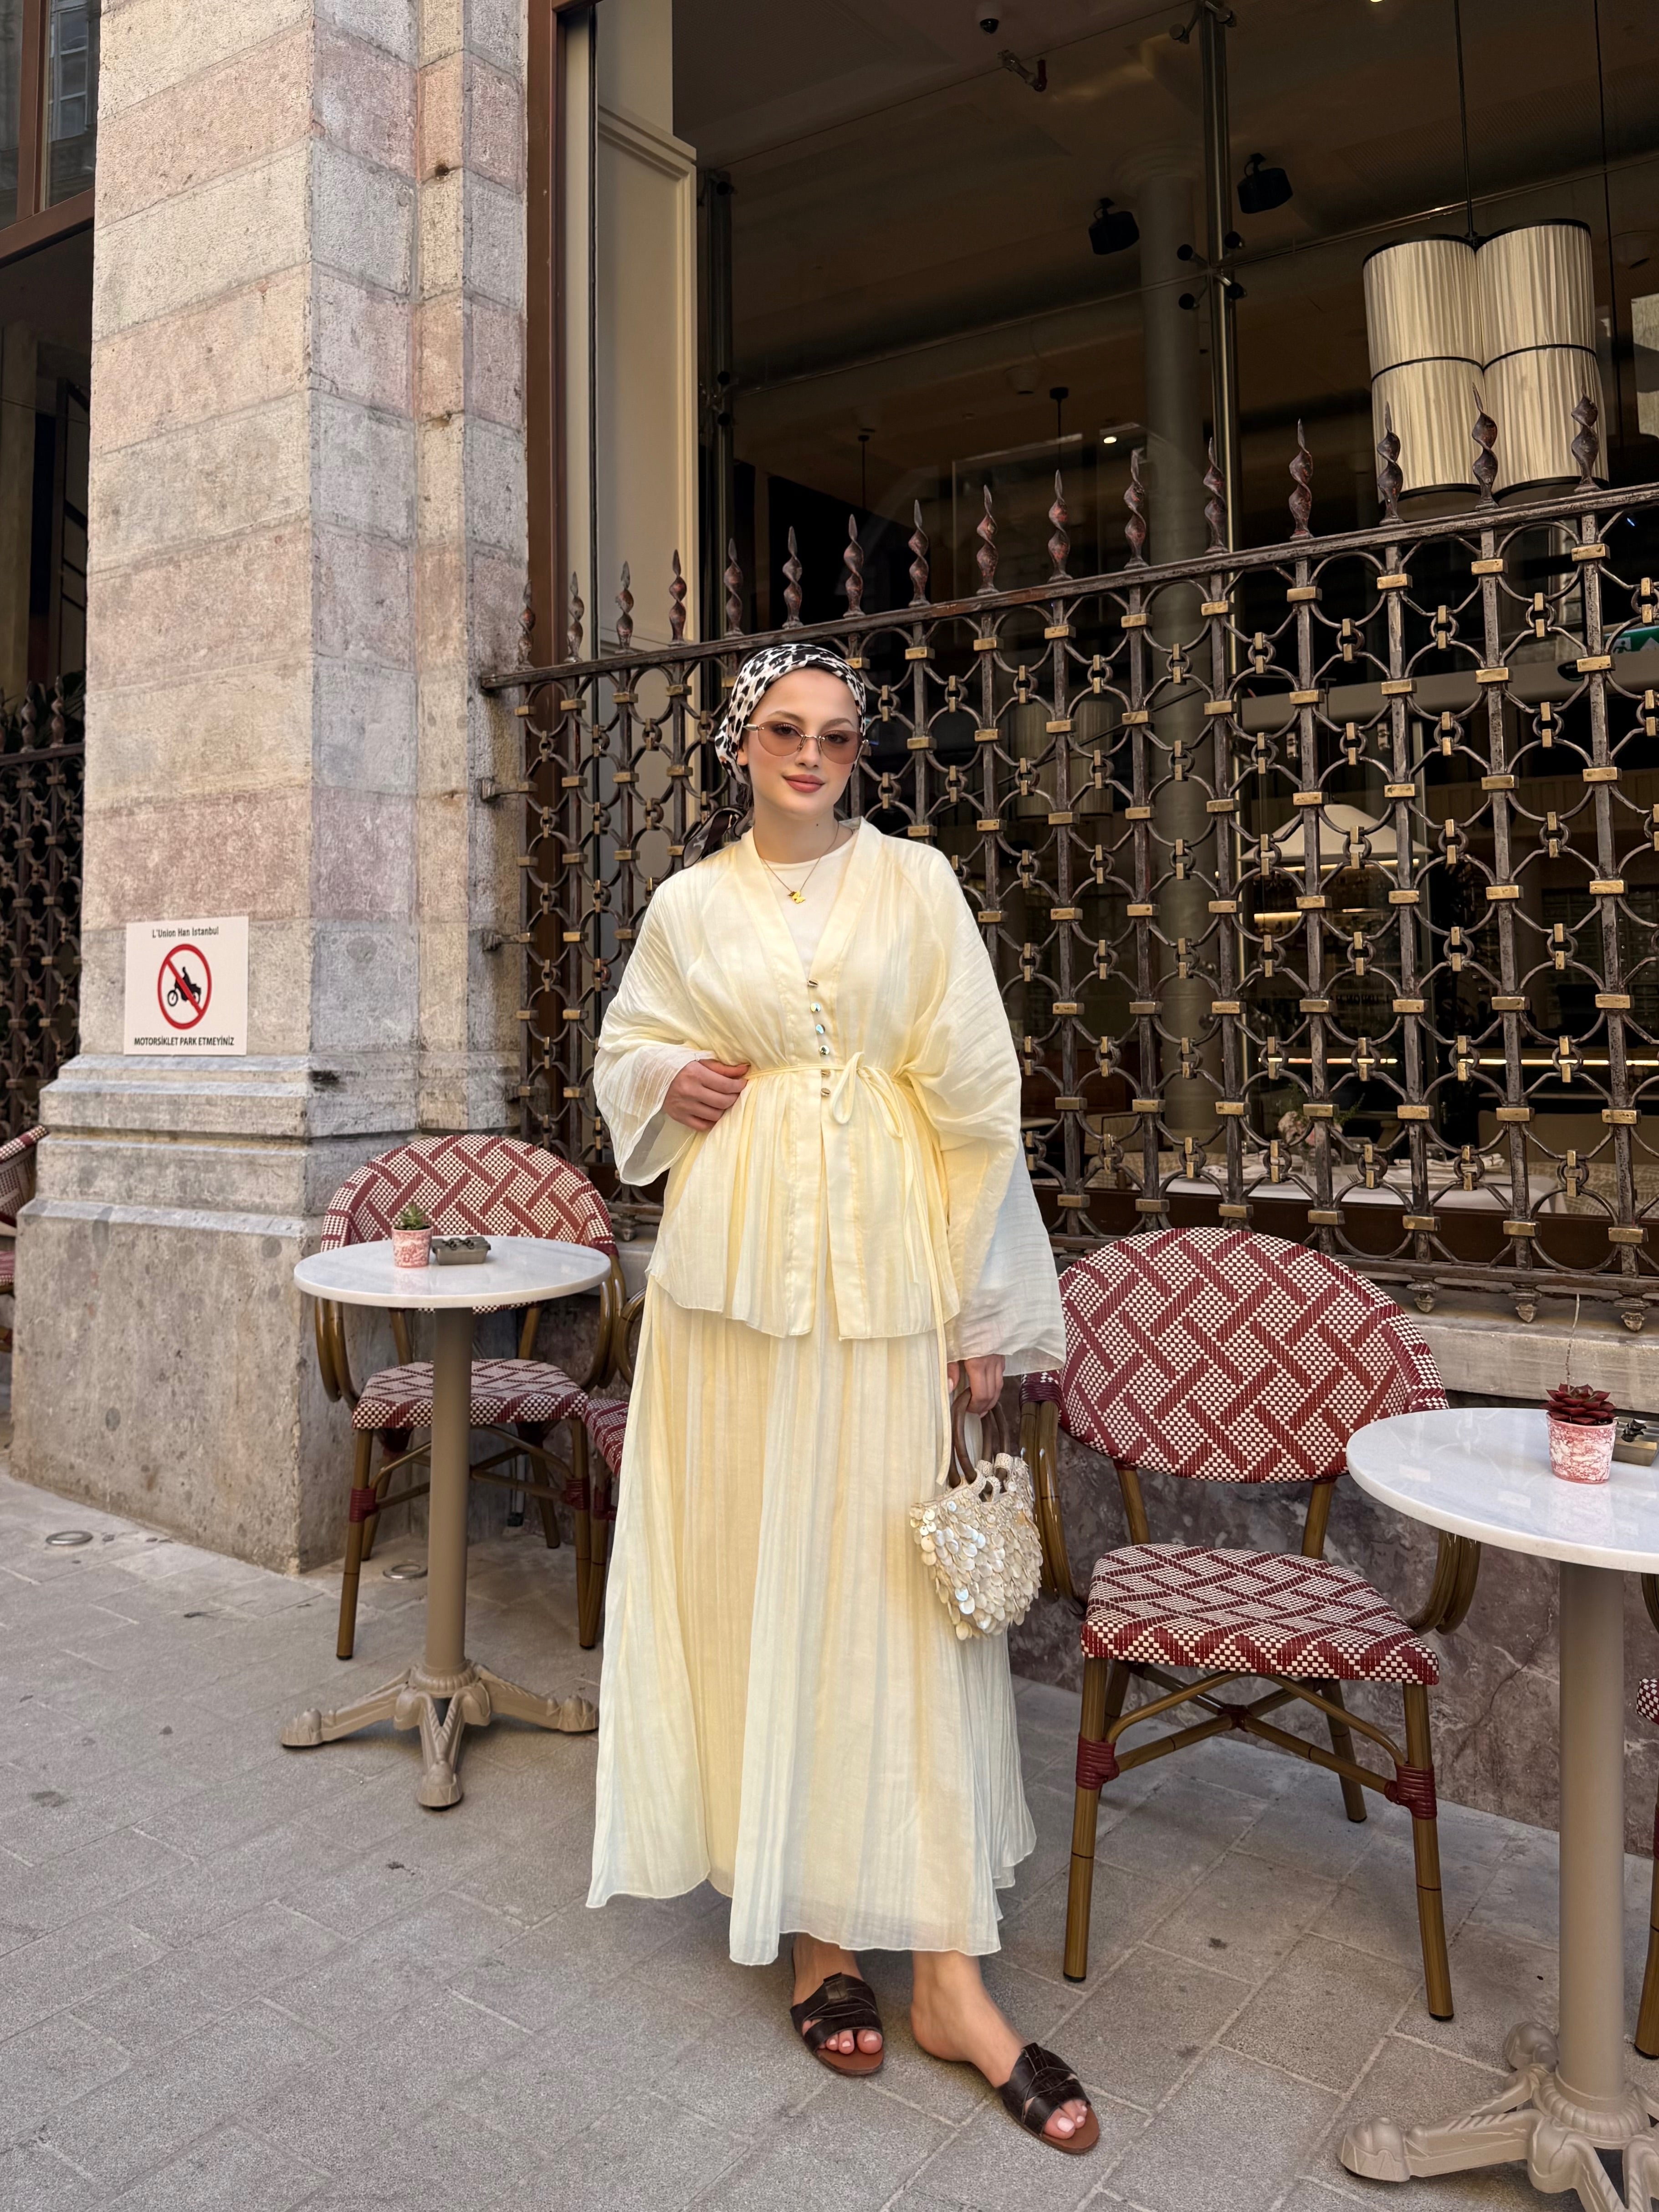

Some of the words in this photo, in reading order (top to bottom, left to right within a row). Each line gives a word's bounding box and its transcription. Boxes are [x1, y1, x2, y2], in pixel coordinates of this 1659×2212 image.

[178, 928, 190, 937] Han
[192, 926, 219, 936] Istanbul
[134, 1035, 179, 1046] MOTORSİKLET
[179, 1037, 197, 1046] PARK
[198, 1035, 235, 1046] ETMEYİNİZ
